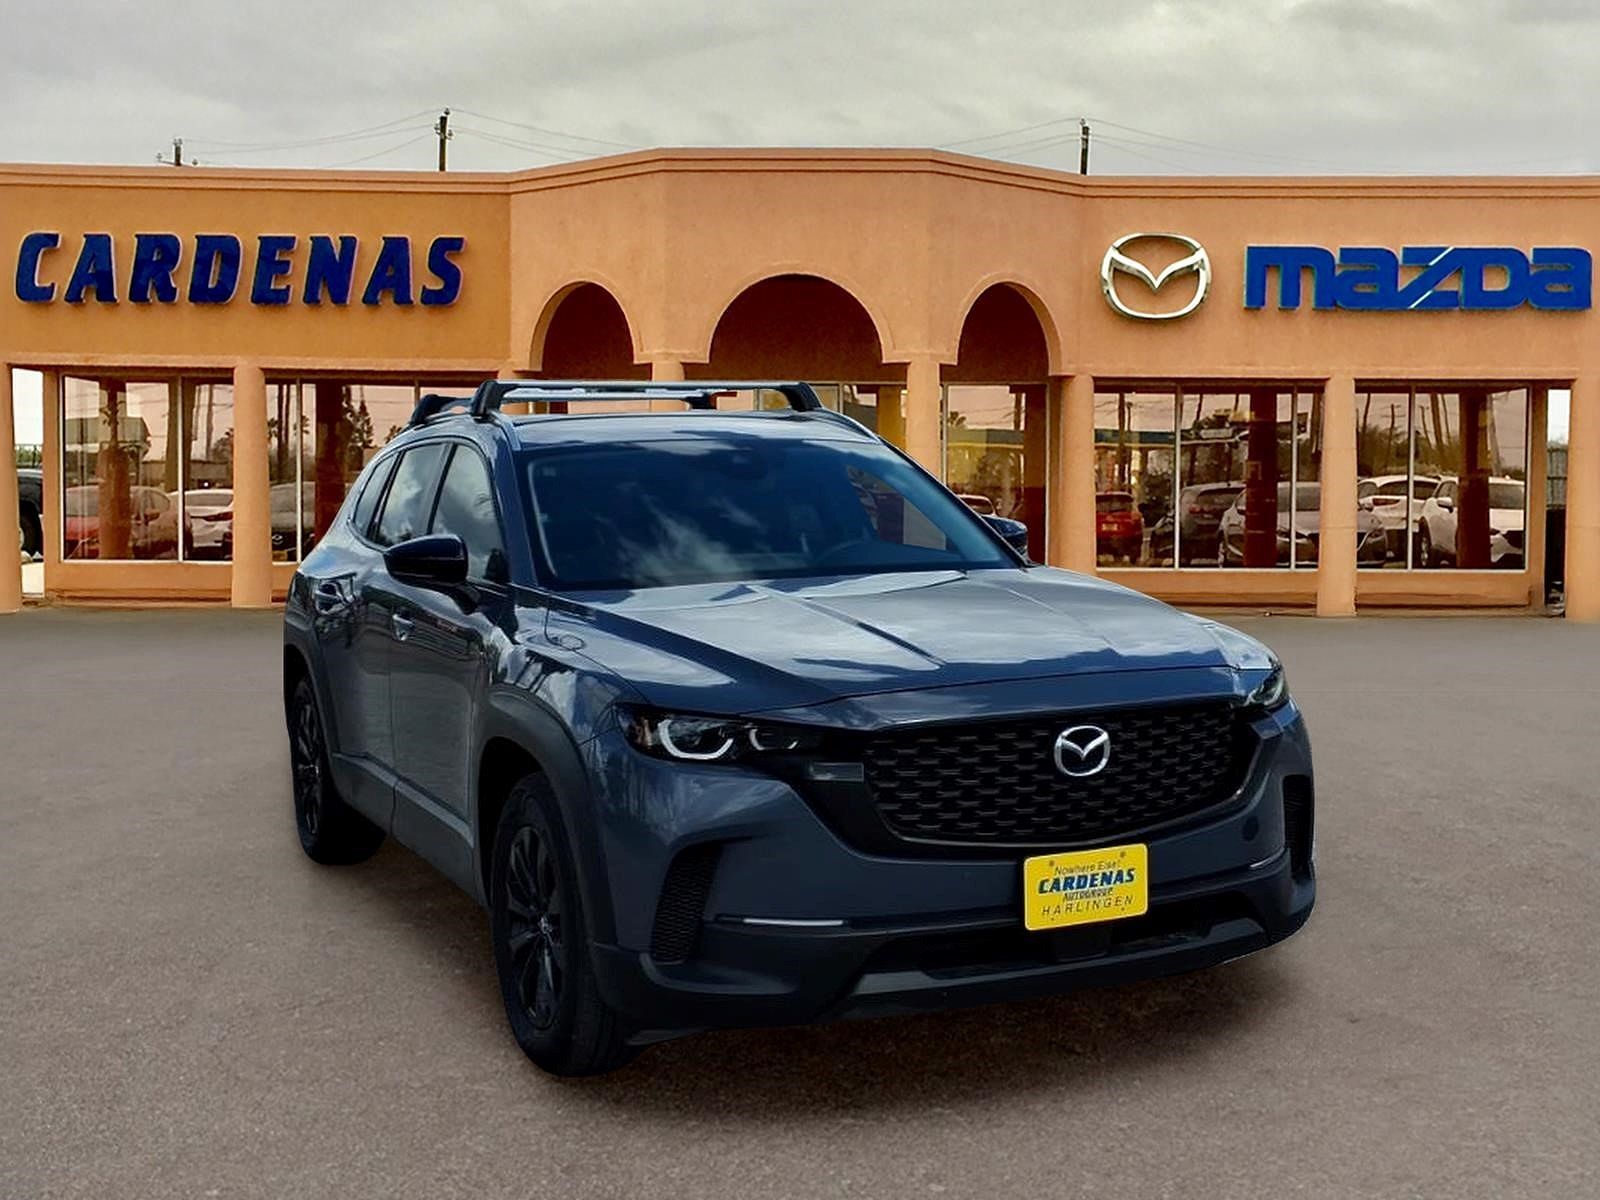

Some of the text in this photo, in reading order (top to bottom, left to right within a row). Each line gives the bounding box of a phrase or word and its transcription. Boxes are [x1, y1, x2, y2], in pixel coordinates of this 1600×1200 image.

[15, 231, 468, 306] CARDENAS
[1038, 868, 1136, 894] CARDENAS
[1042, 895, 1134, 916] HARLINGEN
